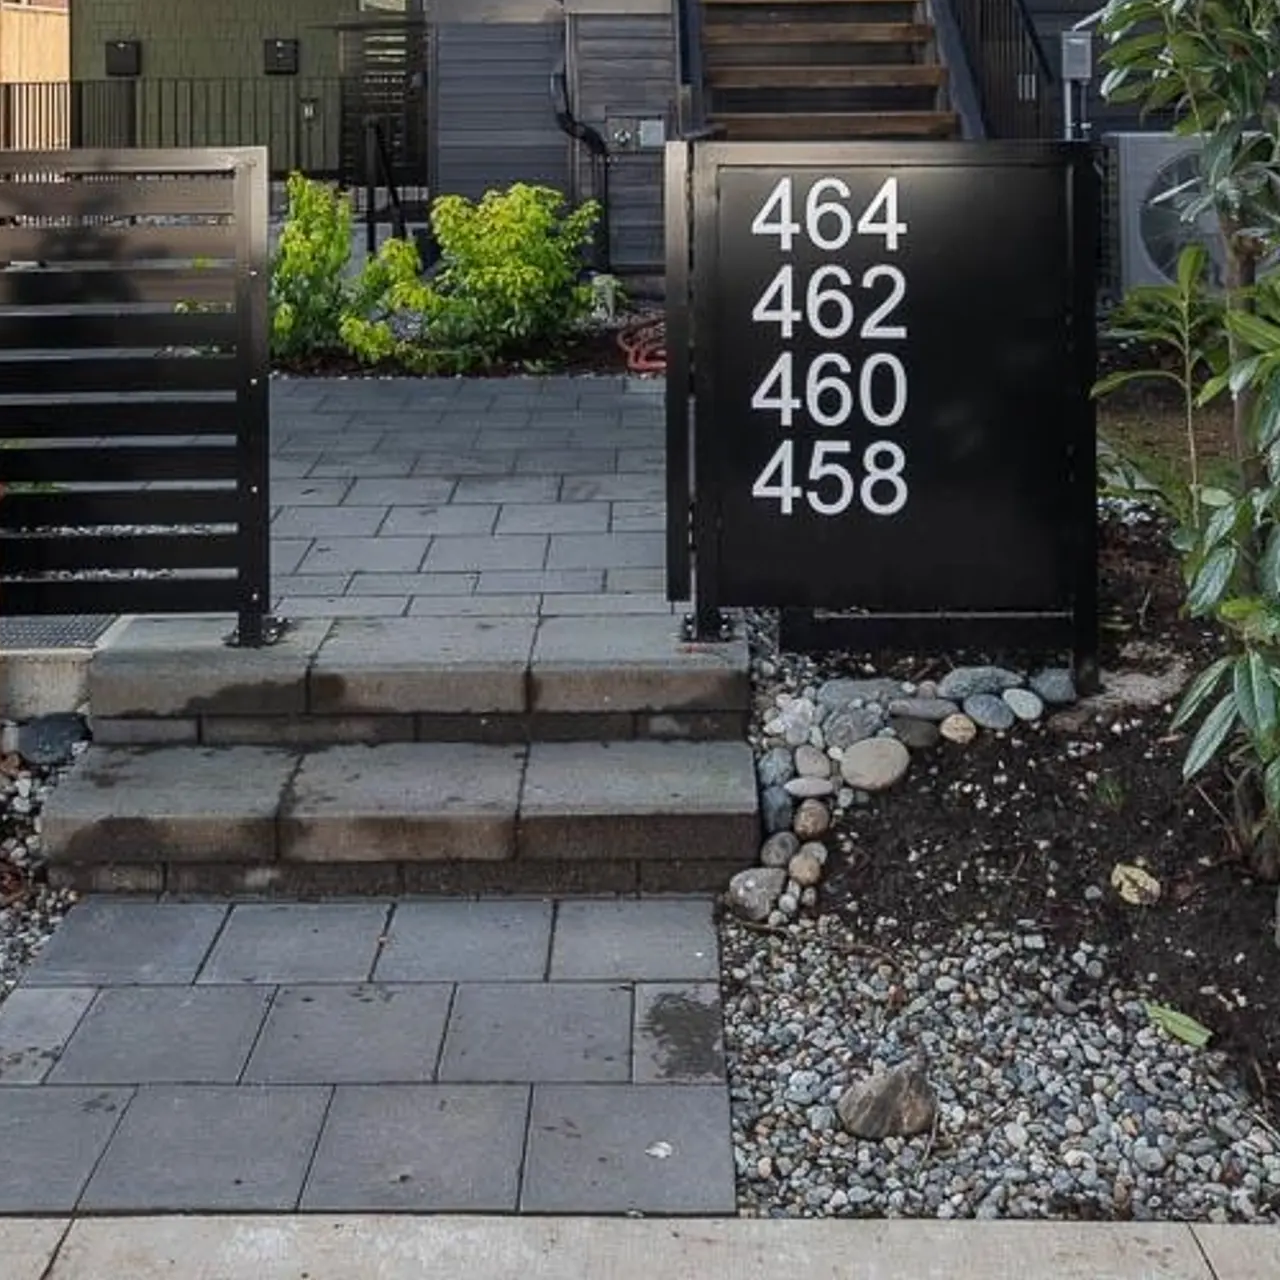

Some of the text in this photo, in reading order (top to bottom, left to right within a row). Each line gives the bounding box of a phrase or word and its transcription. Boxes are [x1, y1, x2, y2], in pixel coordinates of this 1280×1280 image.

[751, 177, 907, 250] 464
[751, 265, 907, 338] 462
[751, 352, 907, 426] 460
[751, 440, 908, 515] 458
